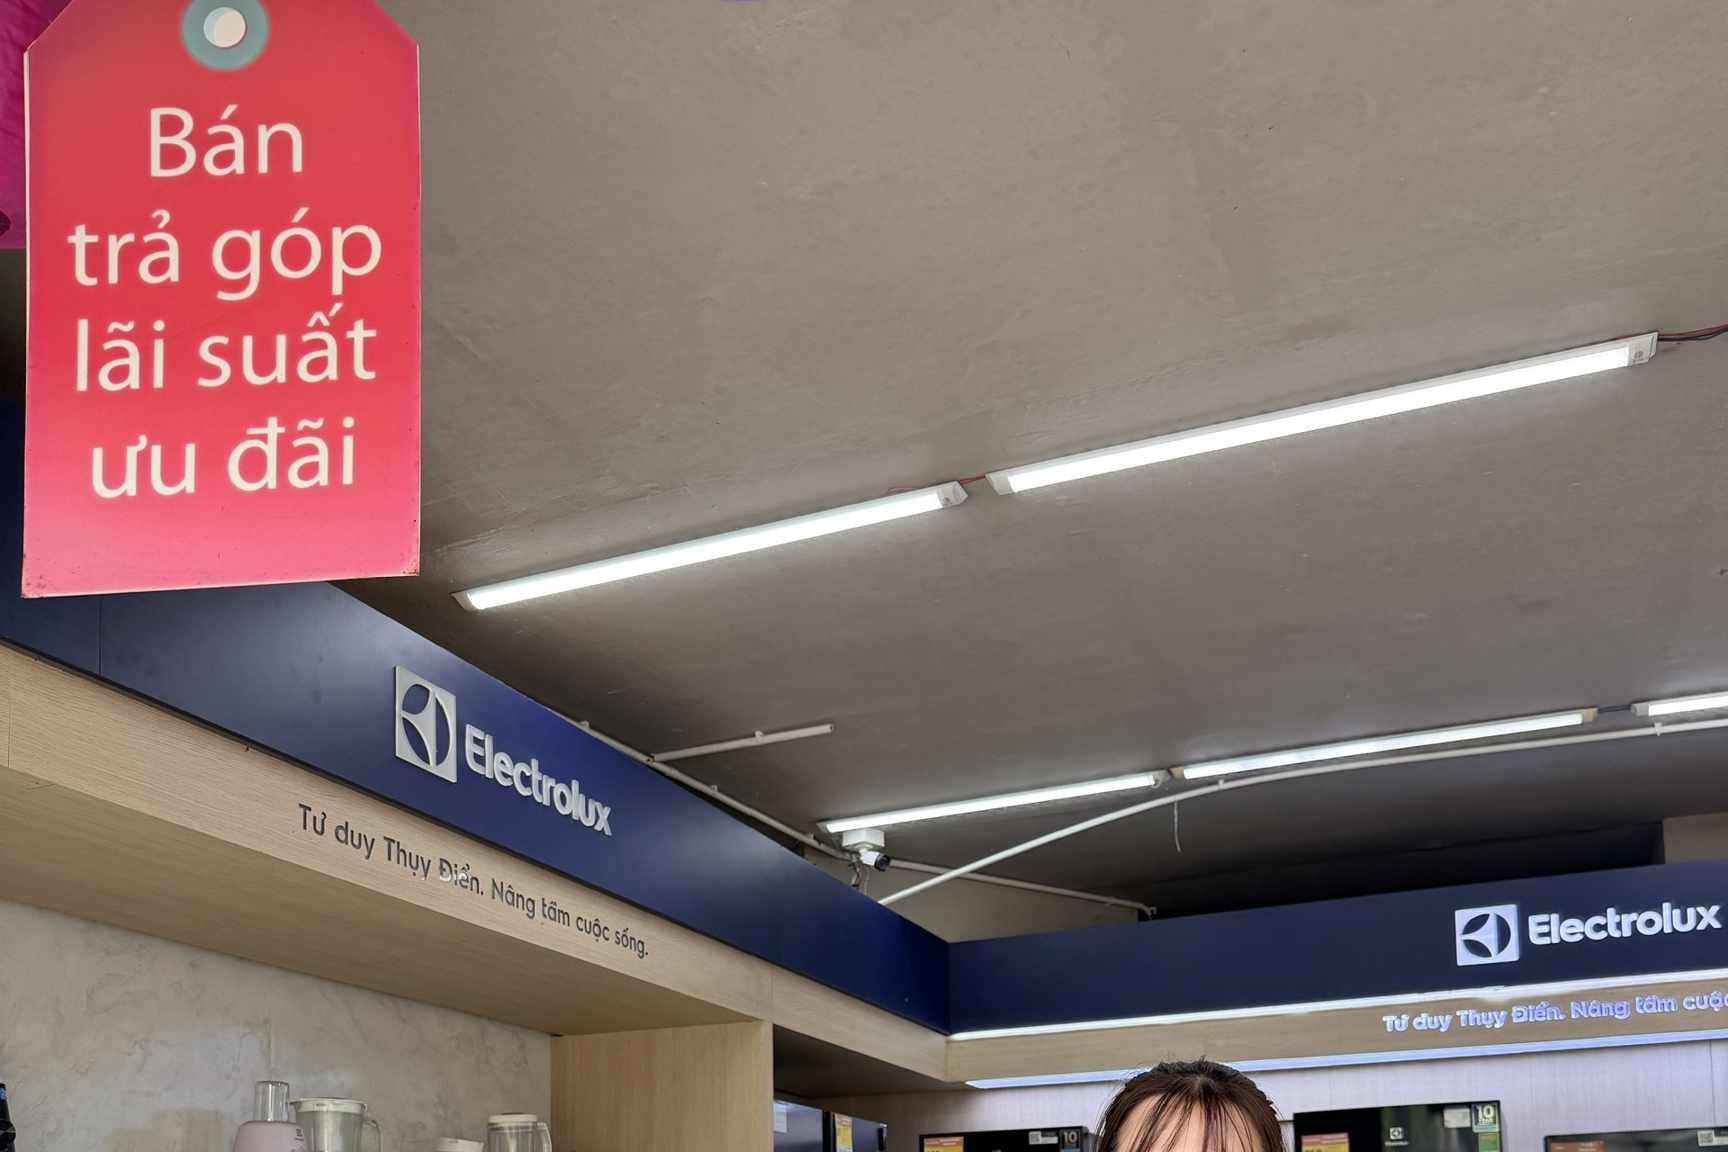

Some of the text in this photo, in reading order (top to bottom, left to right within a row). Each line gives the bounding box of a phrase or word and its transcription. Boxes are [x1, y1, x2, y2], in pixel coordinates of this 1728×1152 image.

[150, 105, 303, 178] Bán
[67, 207, 382, 301] trả góp
[76, 302, 377, 392] lãi suất
[91, 416, 355, 498] ưu đãi
[464, 723, 612, 837] Electrolux
[298, 803, 327, 836] Tư
[335, 821, 375, 860] duy
[384, 836, 431, 880] Thụy
[491, 878, 535, 919] Nâng
[541, 897, 570, 927] tầm
[576, 916, 610, 942] cuộc
[614, 928, 649, 959] sống.
[1527, 902, 1722, 946] Electrolux
[1413, 1013, 1453, 1032] duy
[1456, 1009, 1508, 1028] Thụy
[1570, 1000, 1631, 1020] Nâng
[1063, 1131, 1078, 1143] 10
[1476, 1105, 1495, 1119] 10
